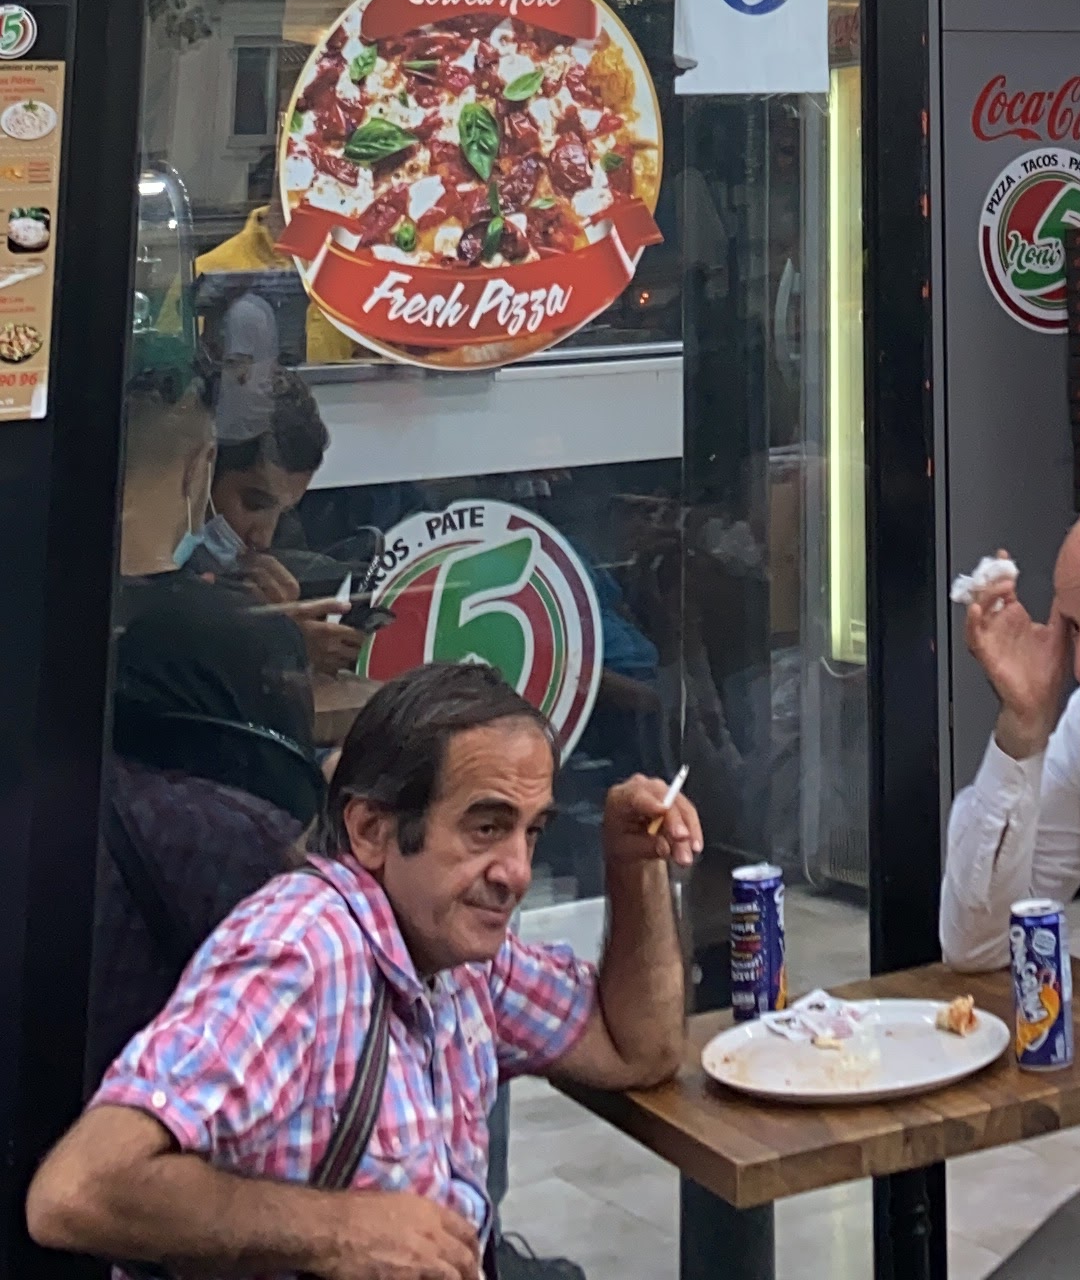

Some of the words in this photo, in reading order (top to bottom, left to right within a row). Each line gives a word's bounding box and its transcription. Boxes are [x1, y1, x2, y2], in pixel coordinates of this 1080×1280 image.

[986, 174, 1017, 215] PIZZA
[1020, 154, 1059, 175] TACOS
[362, 270, 470, 329] Fresh
[468, 278, 574, 337] Pizza
[425, 506, 486, 540] PATE
